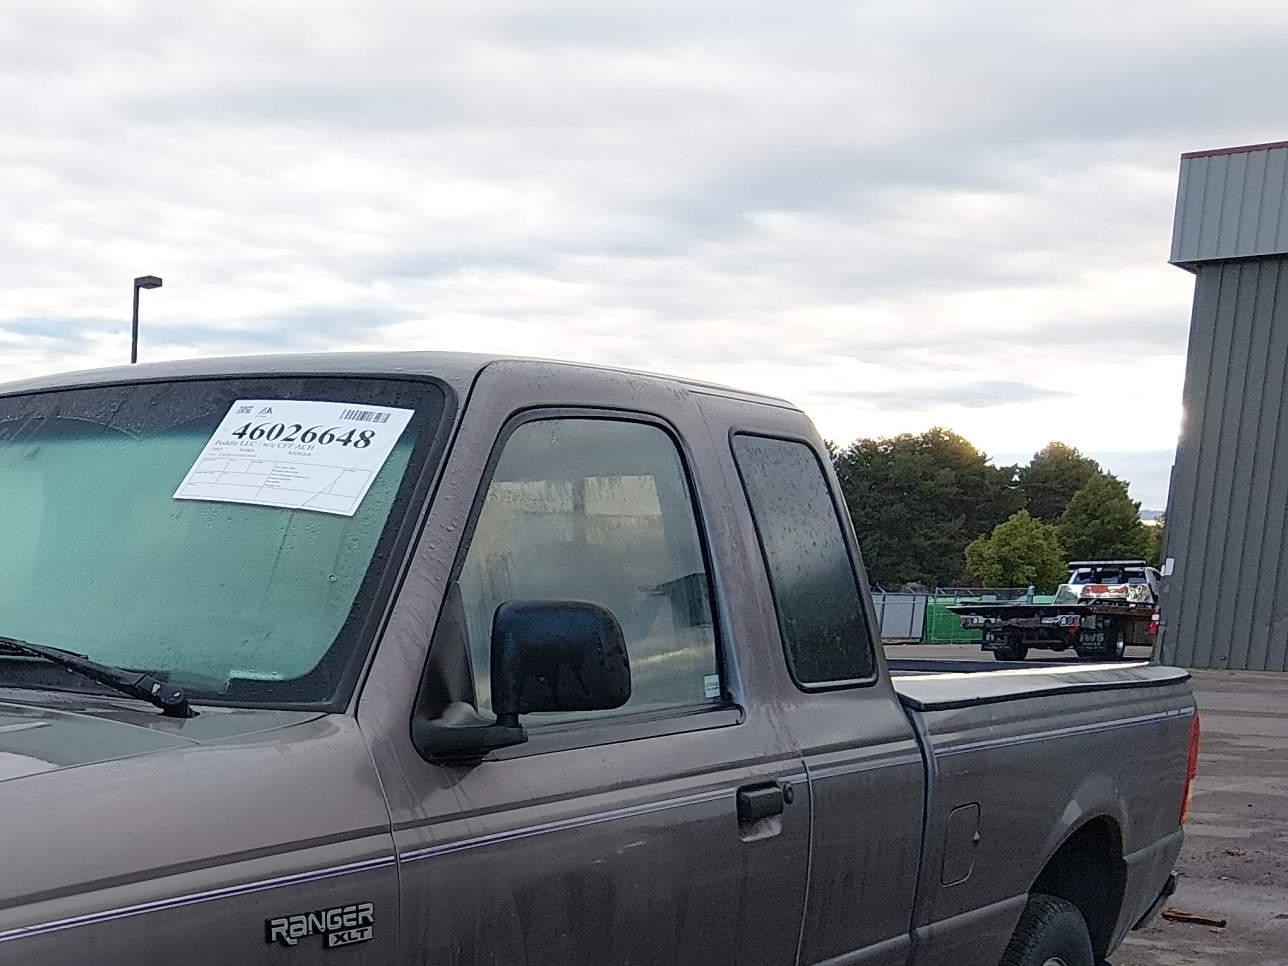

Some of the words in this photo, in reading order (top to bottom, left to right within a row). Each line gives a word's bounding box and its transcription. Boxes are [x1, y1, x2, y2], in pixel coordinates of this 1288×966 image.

[231, 422, 376, 449] 46026648
[268, 903, 374, 945] RANGER
[330, 927, 373, 947] XLT
